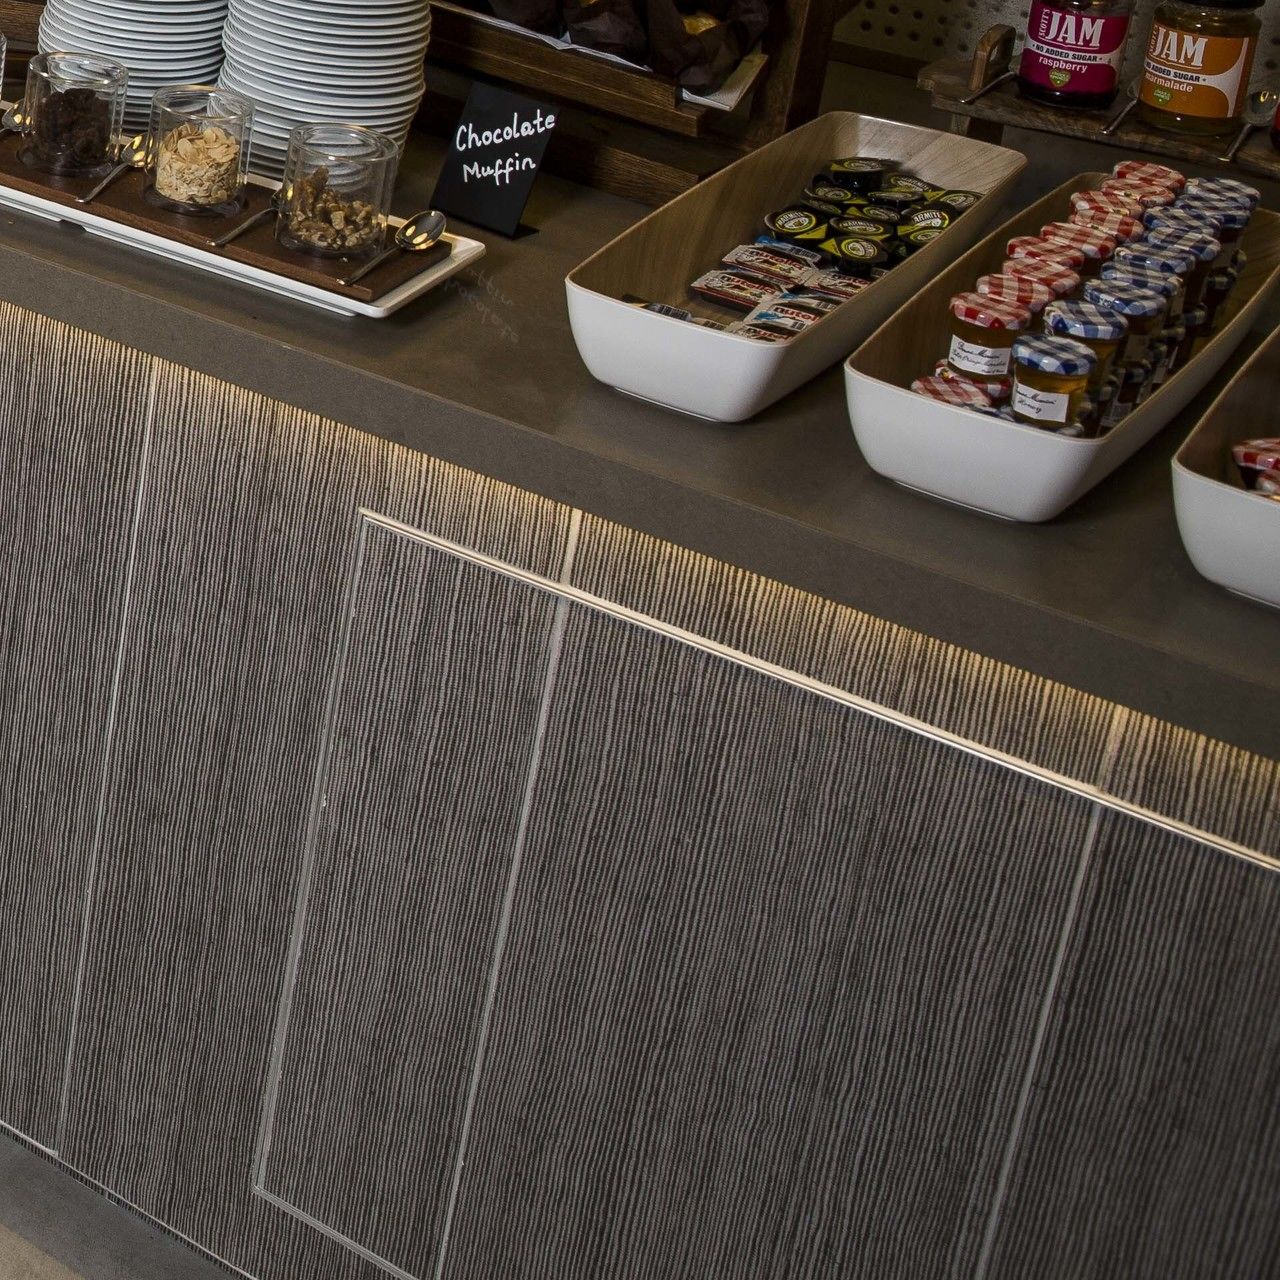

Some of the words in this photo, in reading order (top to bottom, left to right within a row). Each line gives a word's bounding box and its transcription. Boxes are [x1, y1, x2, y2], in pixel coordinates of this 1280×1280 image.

[1045, 10, 1105, 48] JAM
[1035, 44, 1044, 53] NO
[1045, 46, 1070, 59] ADDED
[1071, 52, 1098, 62] SUGAR
[1153, 26, 1208, 67] JAM
[1038, 56, 1088, 74] raspberry
[1152, 64, 1171, 77] ADDED
[1173, 71, 1201, 82] SUGAR
[1145, 72, 1193, 93] marmalade
[455, 108, 555, 152] Chocolate
[462, 152, 537, 186] Muffin
[748, 249, 805, 271] nutella
[720, 274, 777, 295] nutella
